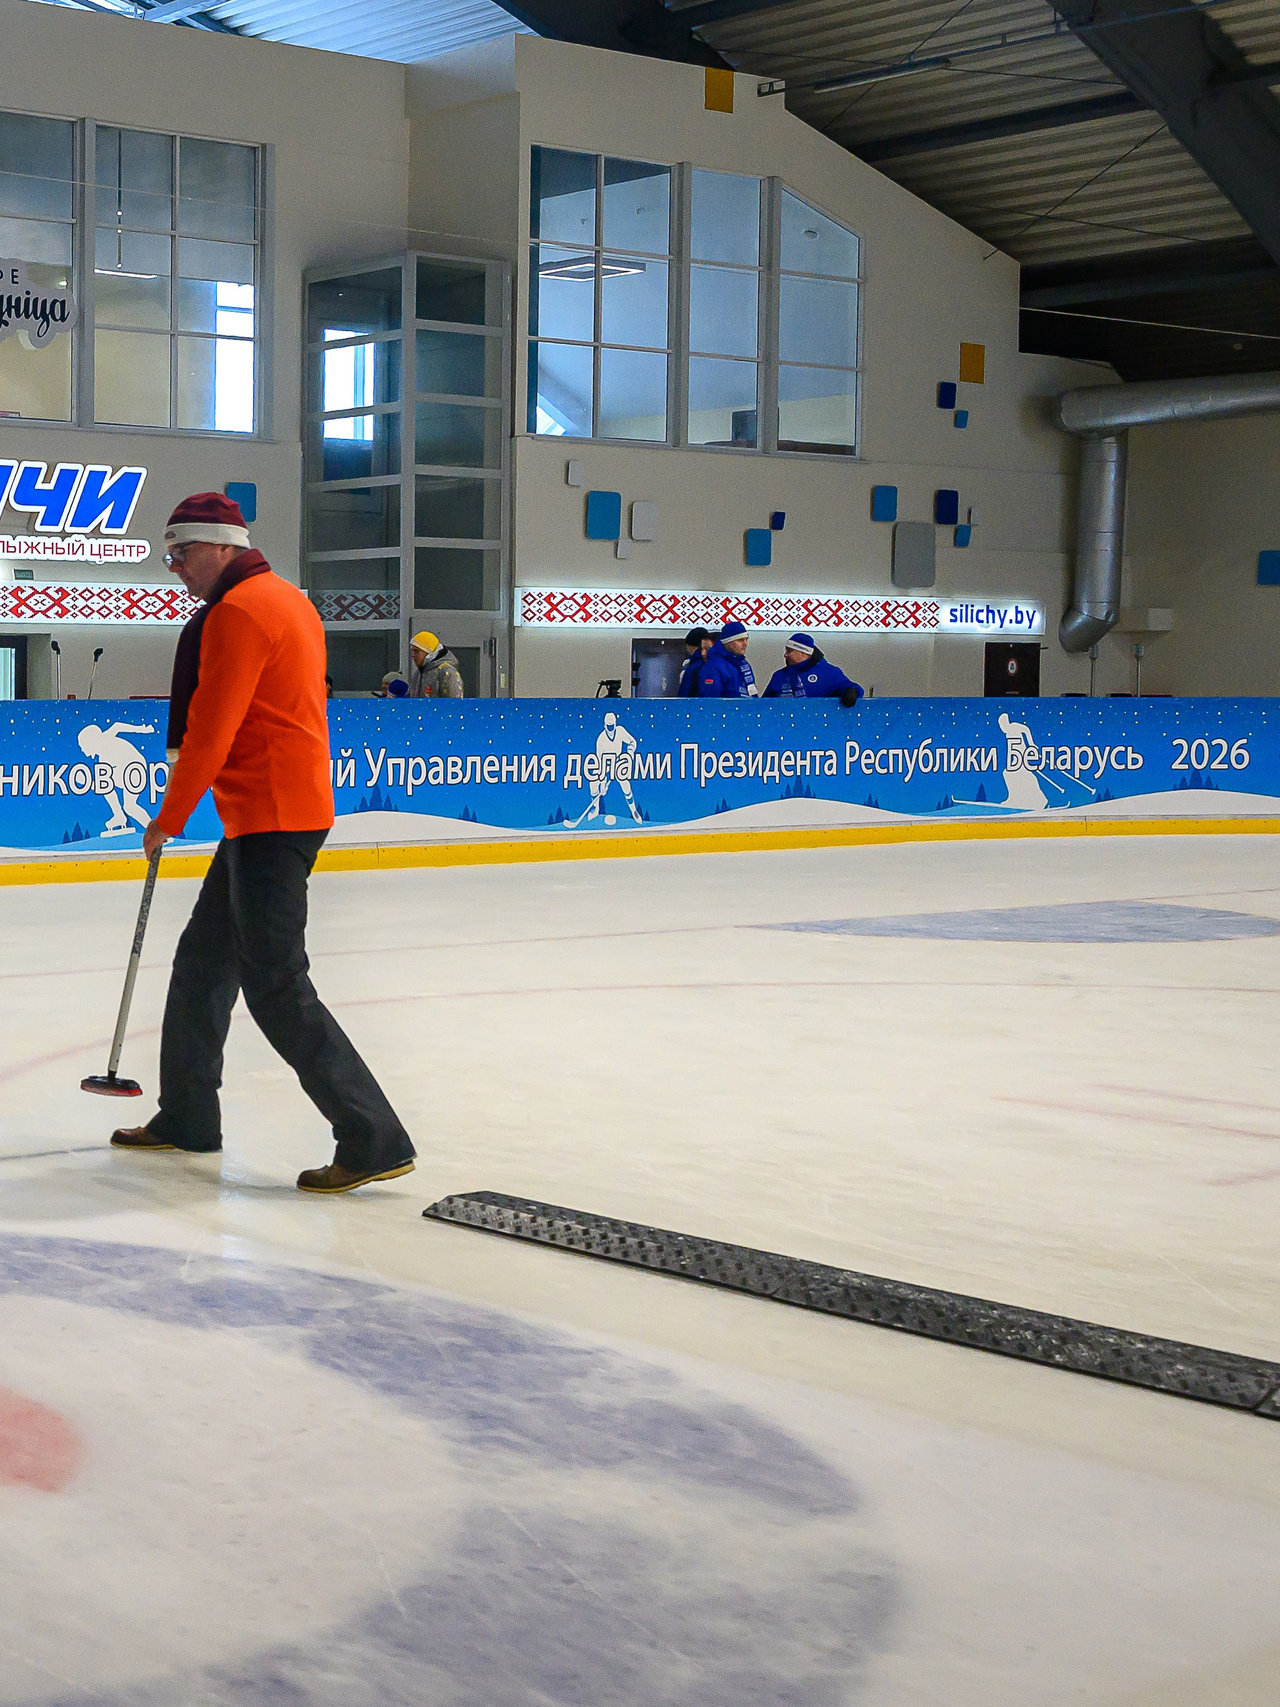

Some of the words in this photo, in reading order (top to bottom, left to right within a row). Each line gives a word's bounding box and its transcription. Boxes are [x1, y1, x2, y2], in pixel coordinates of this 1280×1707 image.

[89, 544, 147, 560] ЦЕНТР
[949, 603, 1037, 630] silichy.by
[363, 746, 557, 796] Управления
[563, 749, 673, 789] делами
[678, 742, 838, 788] Президента
[843, 737, 999, 783] Республики
[1005, 737, 1144, 780] Беларусь
[1170, 737, 1251, 771] 2026
